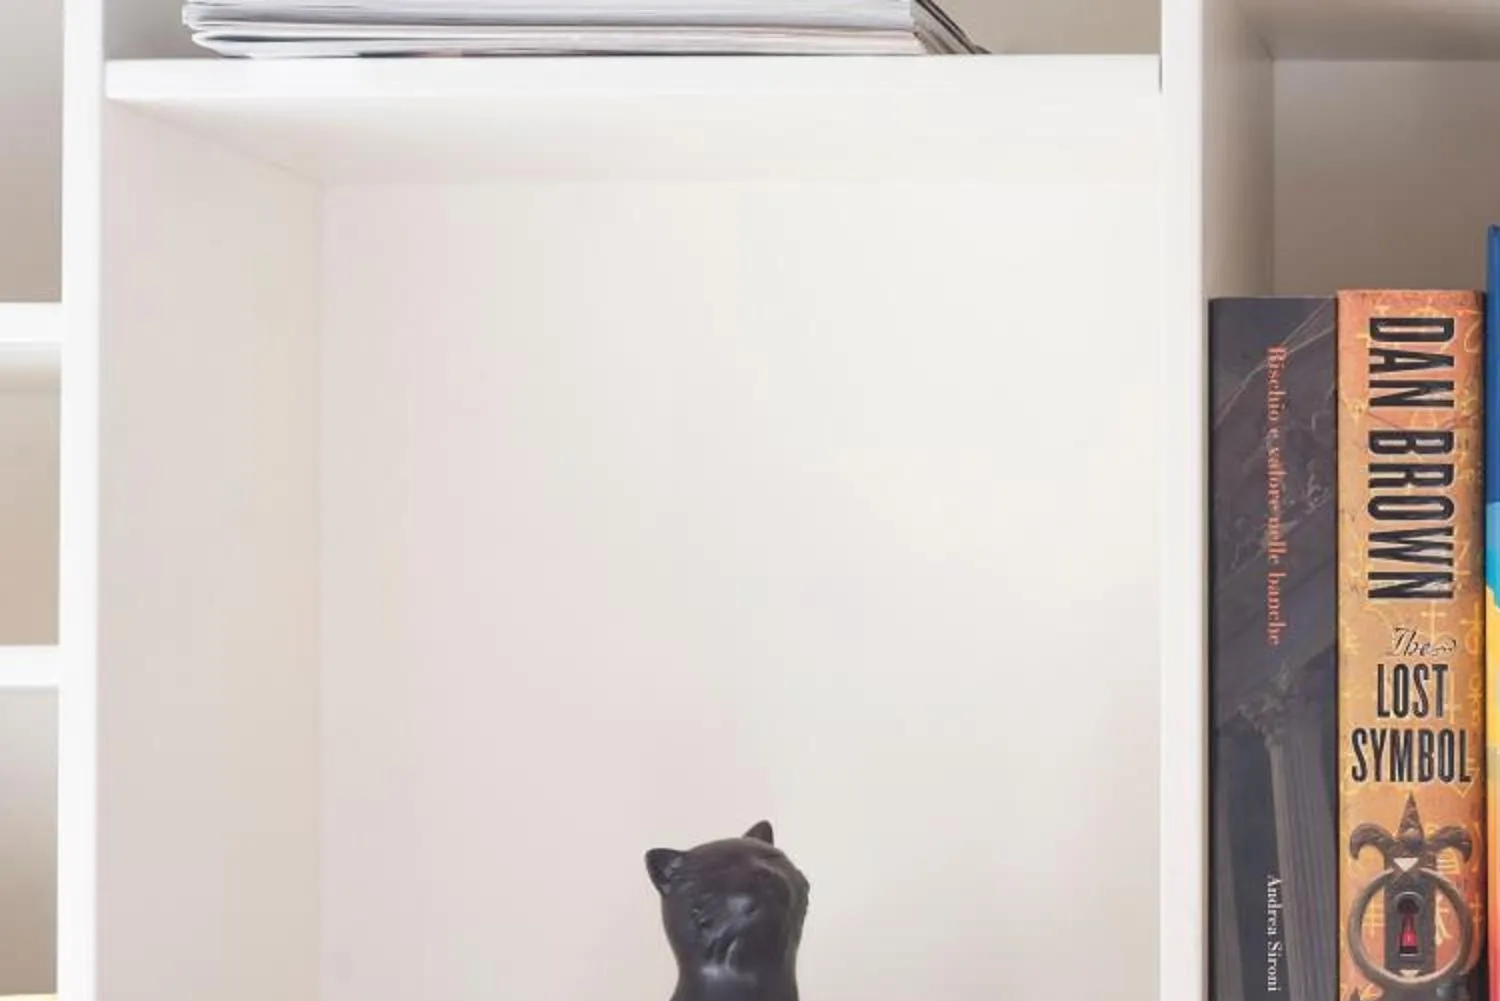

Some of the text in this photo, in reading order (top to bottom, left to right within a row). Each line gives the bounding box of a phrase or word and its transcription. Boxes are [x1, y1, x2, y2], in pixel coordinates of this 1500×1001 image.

[1266, 345, 1288, 646] Rischio e valore nelle banche
[1367, 317, 1455, 599] DAN BROWN
[1387, 626, 1456, 657] The
[1377, 663, 1449, 718] LOST
[1351, 727, 1472, 783] SYMBOL
[1267, 875, 1284, 992] Andrea Sironi
